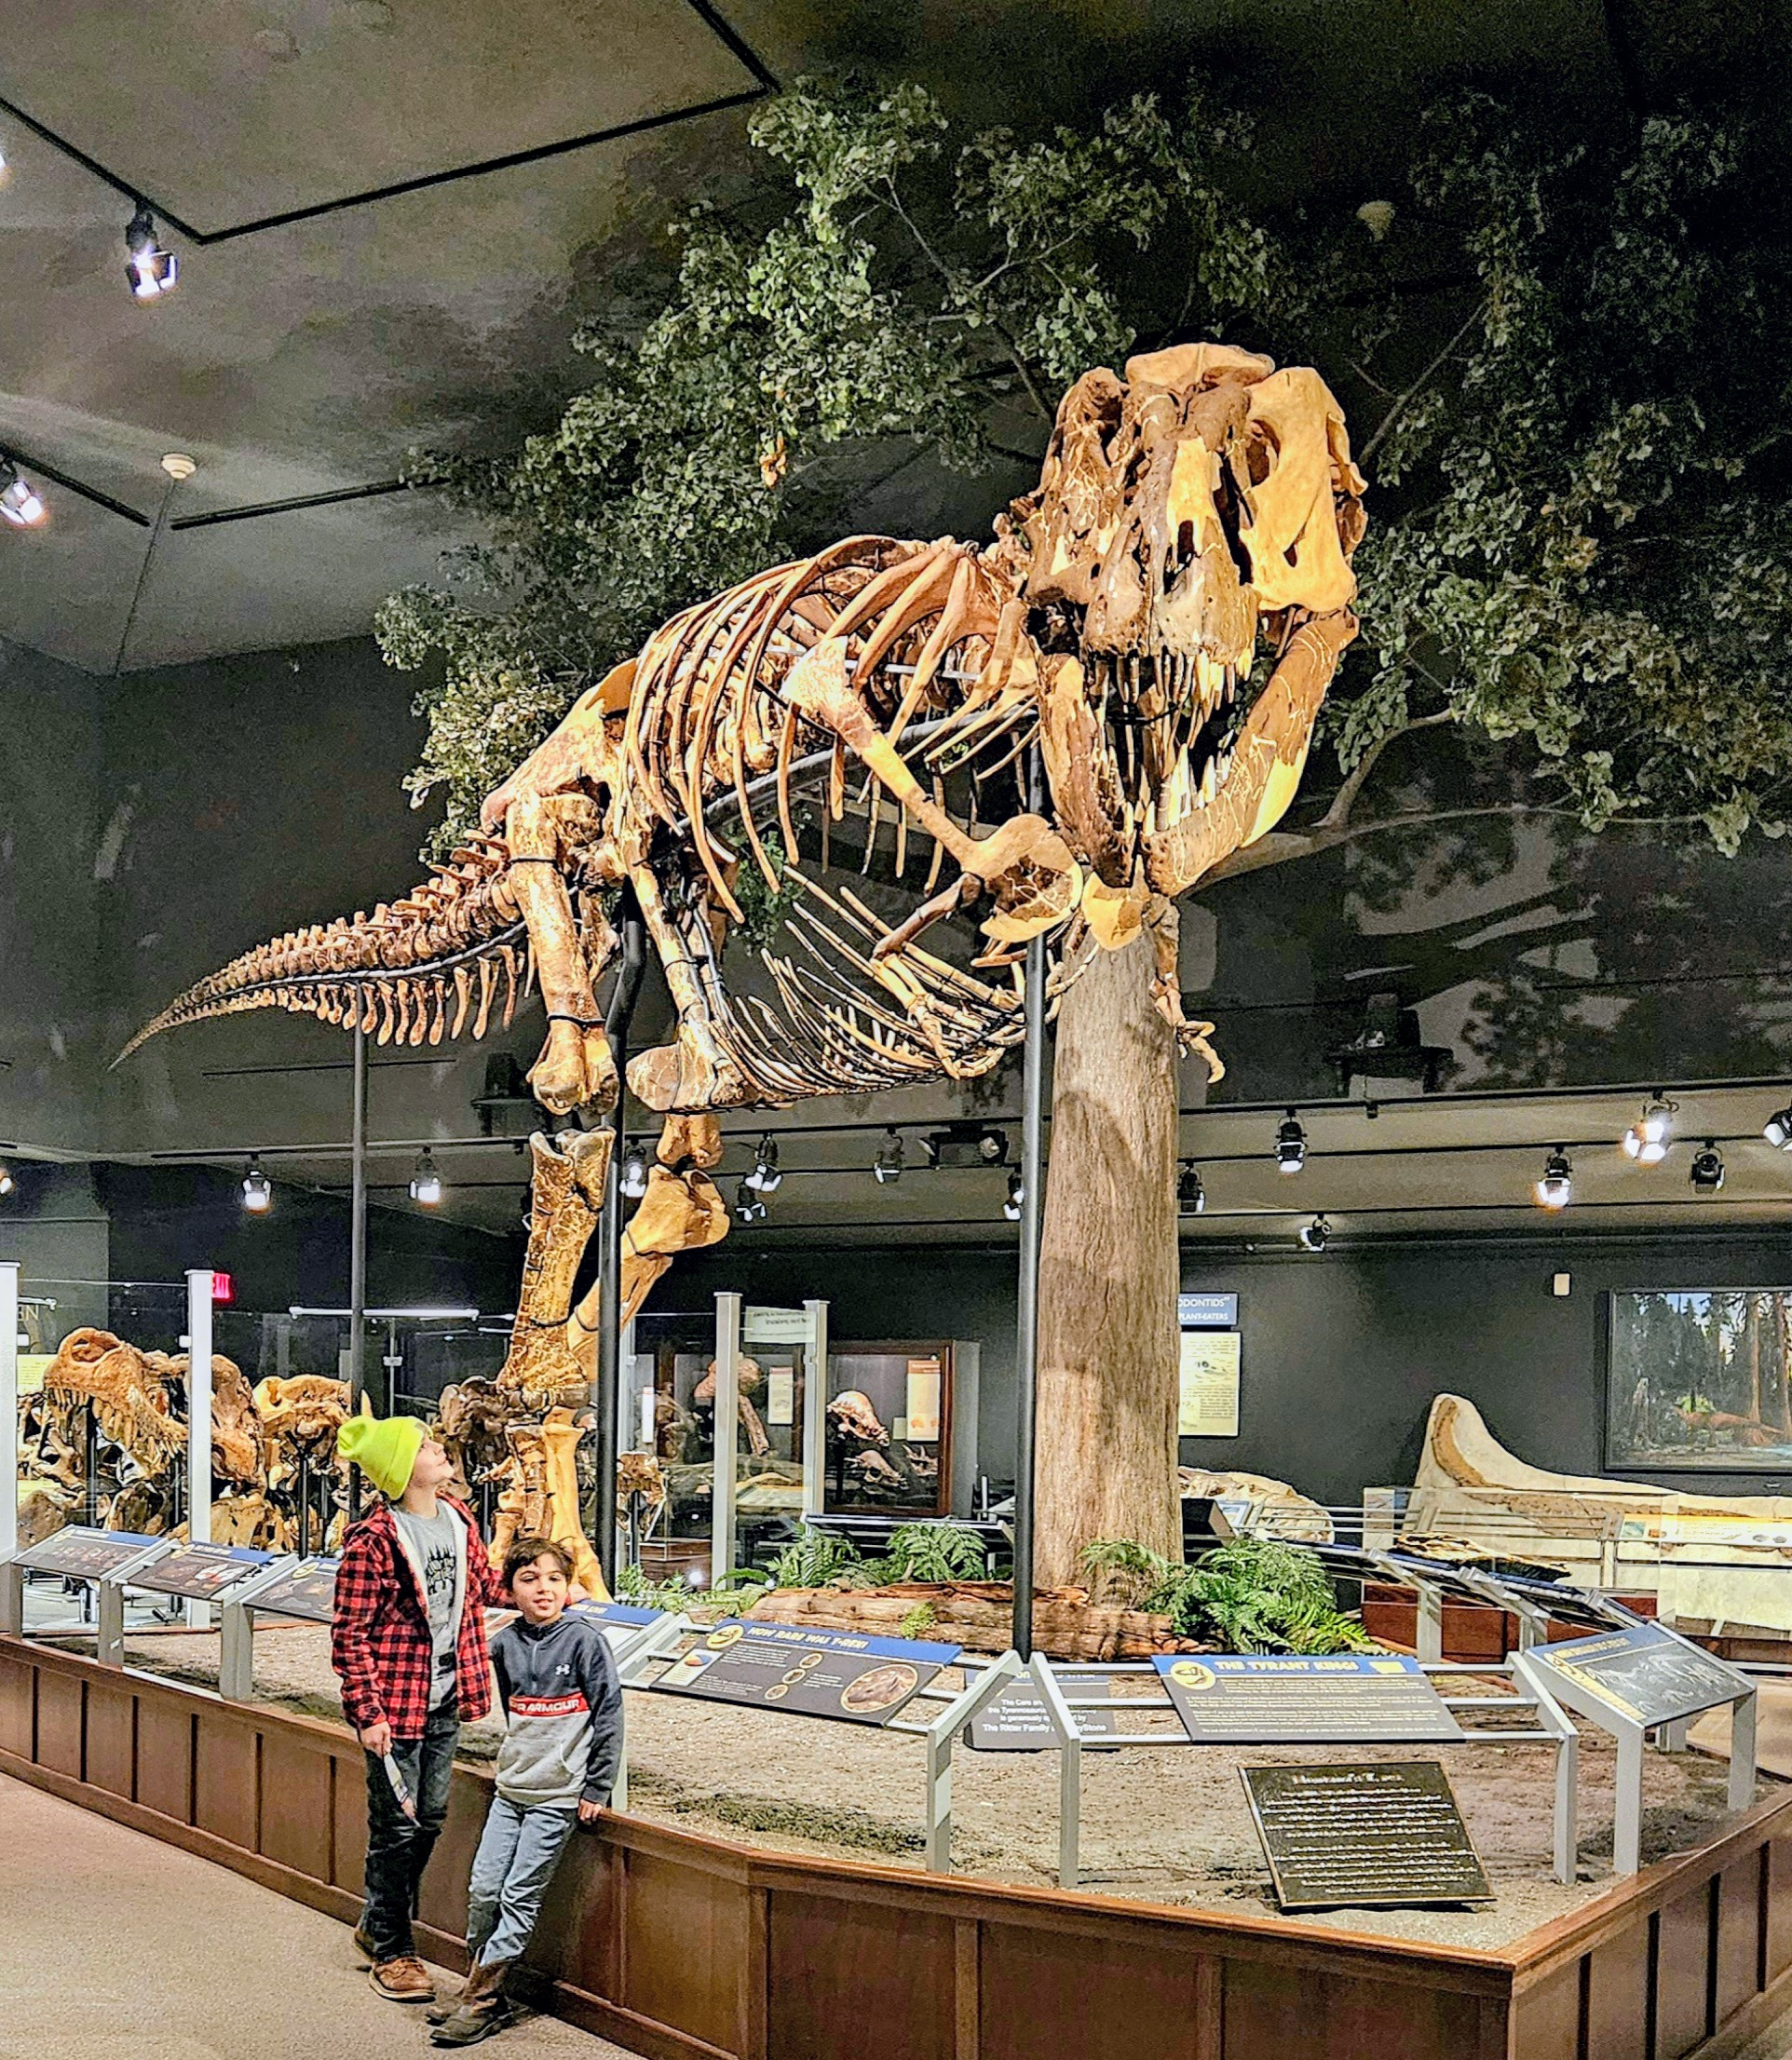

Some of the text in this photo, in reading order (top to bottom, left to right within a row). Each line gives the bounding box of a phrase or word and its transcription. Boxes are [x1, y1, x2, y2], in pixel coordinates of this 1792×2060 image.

[1178, 1296, 1229, 1308] ODONTIDS"
[747, 1626, 777, 1638] HOW
[804, 1633, 833, 1645] WAS
[1213, 1660, 1246, 1672] THE
[1246, 1660, 1310, 1672] TYRANT
[527, 1699, 580, 1713] ARMOUR
[982, 1723, 998, 1732] The
[1023, 1723, 1051, 1733] Family
[1079, 1724, 1107, 1733] yStone
